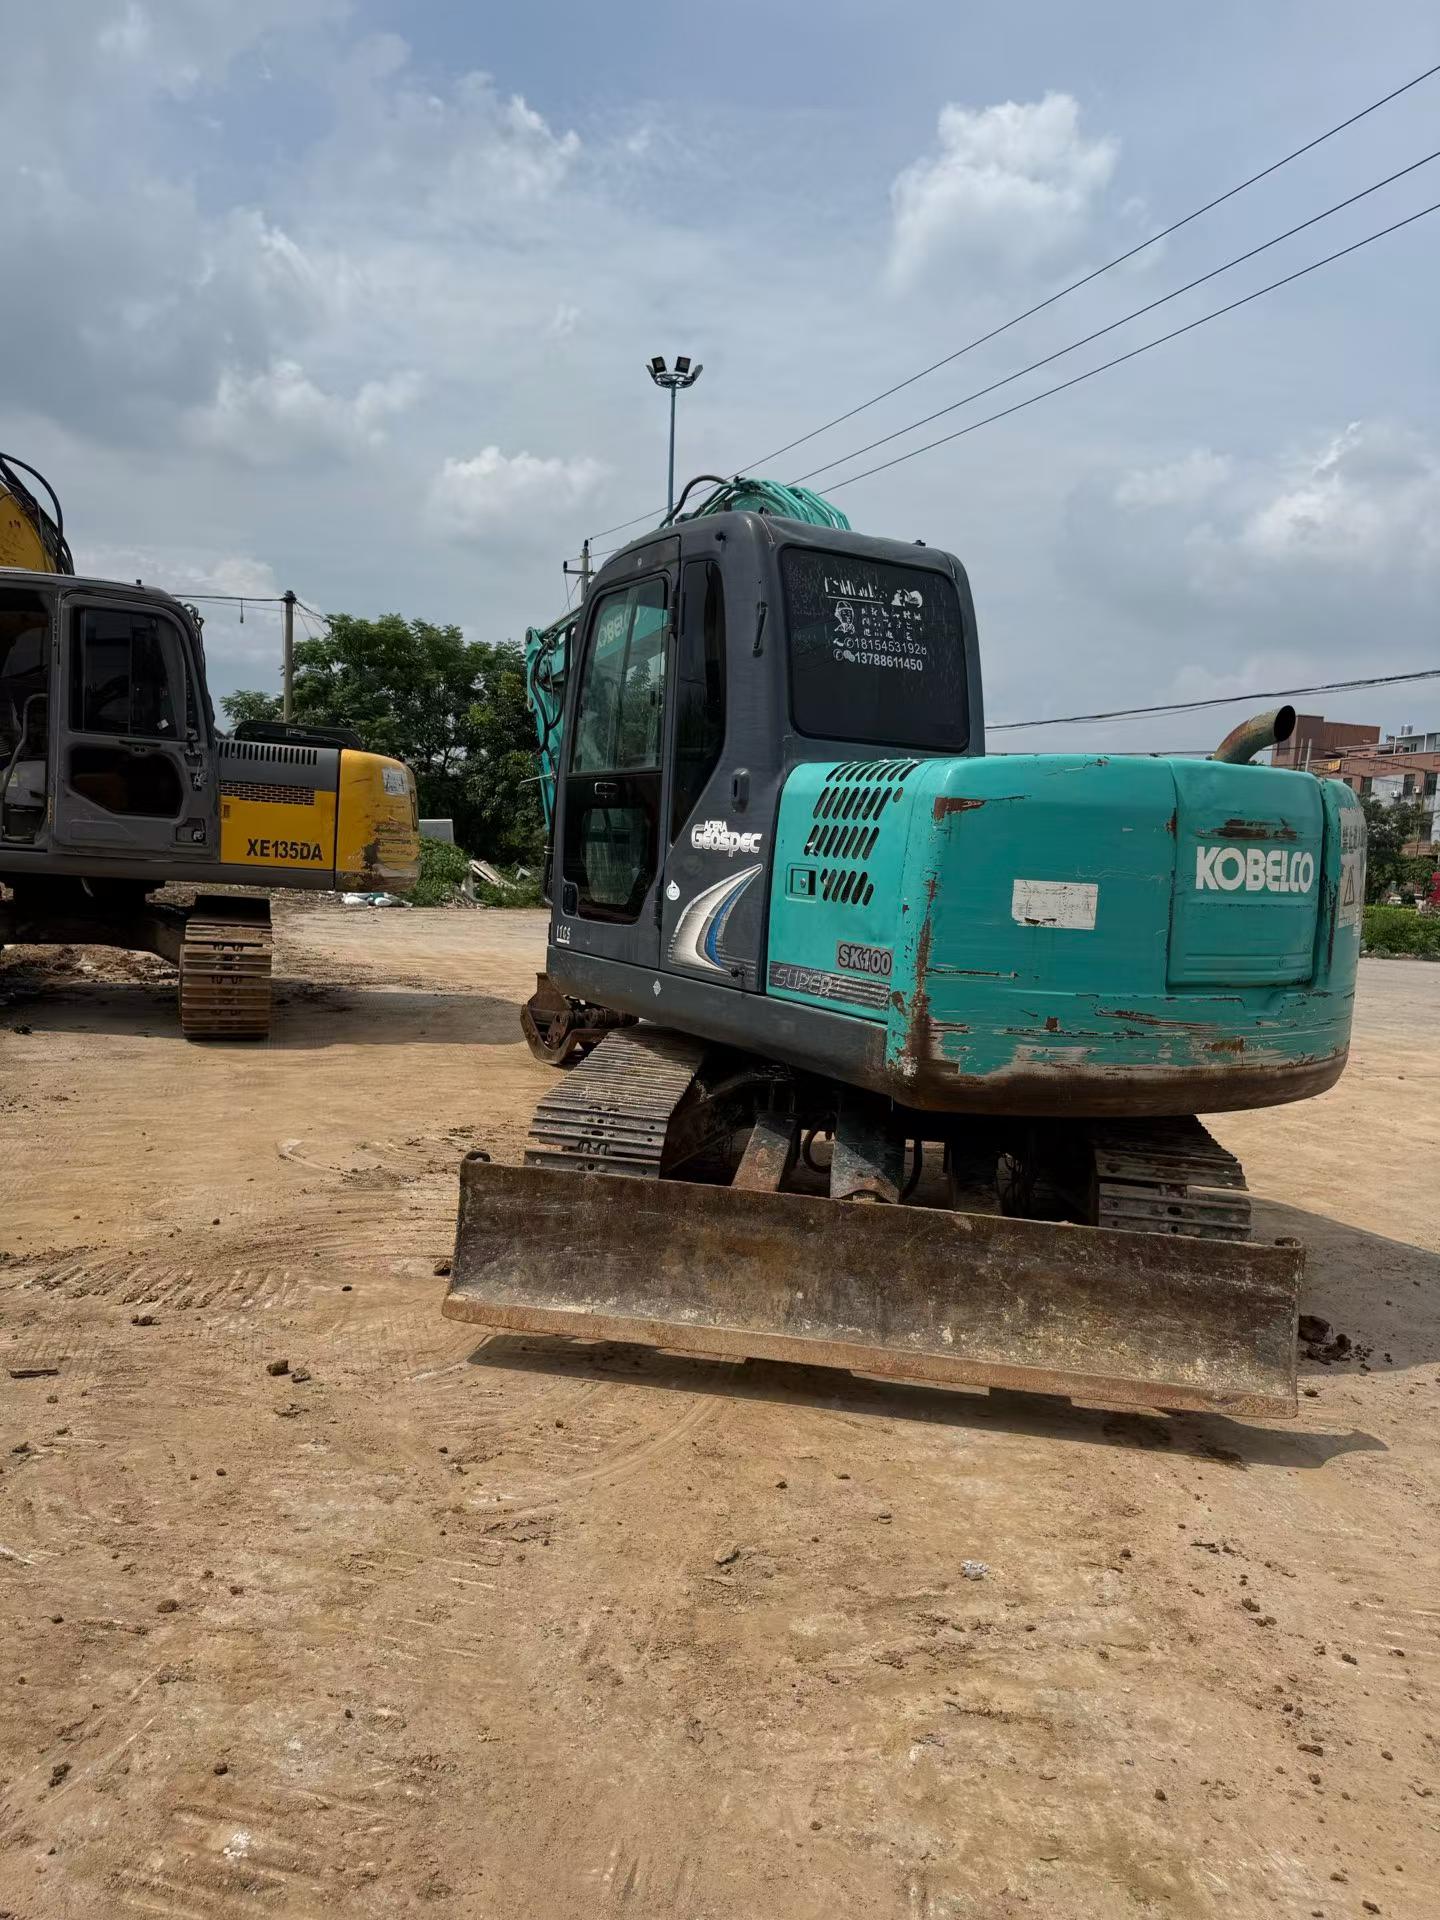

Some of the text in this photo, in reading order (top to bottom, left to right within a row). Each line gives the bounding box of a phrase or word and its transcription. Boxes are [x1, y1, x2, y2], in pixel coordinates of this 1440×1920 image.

[855, 651, 923, 671] 13788611450
[246, 838, 323, 861] XE135DA
[1195, 846, 1315, 893] KOBELCO
[838, 944, 892, 976] SK100
